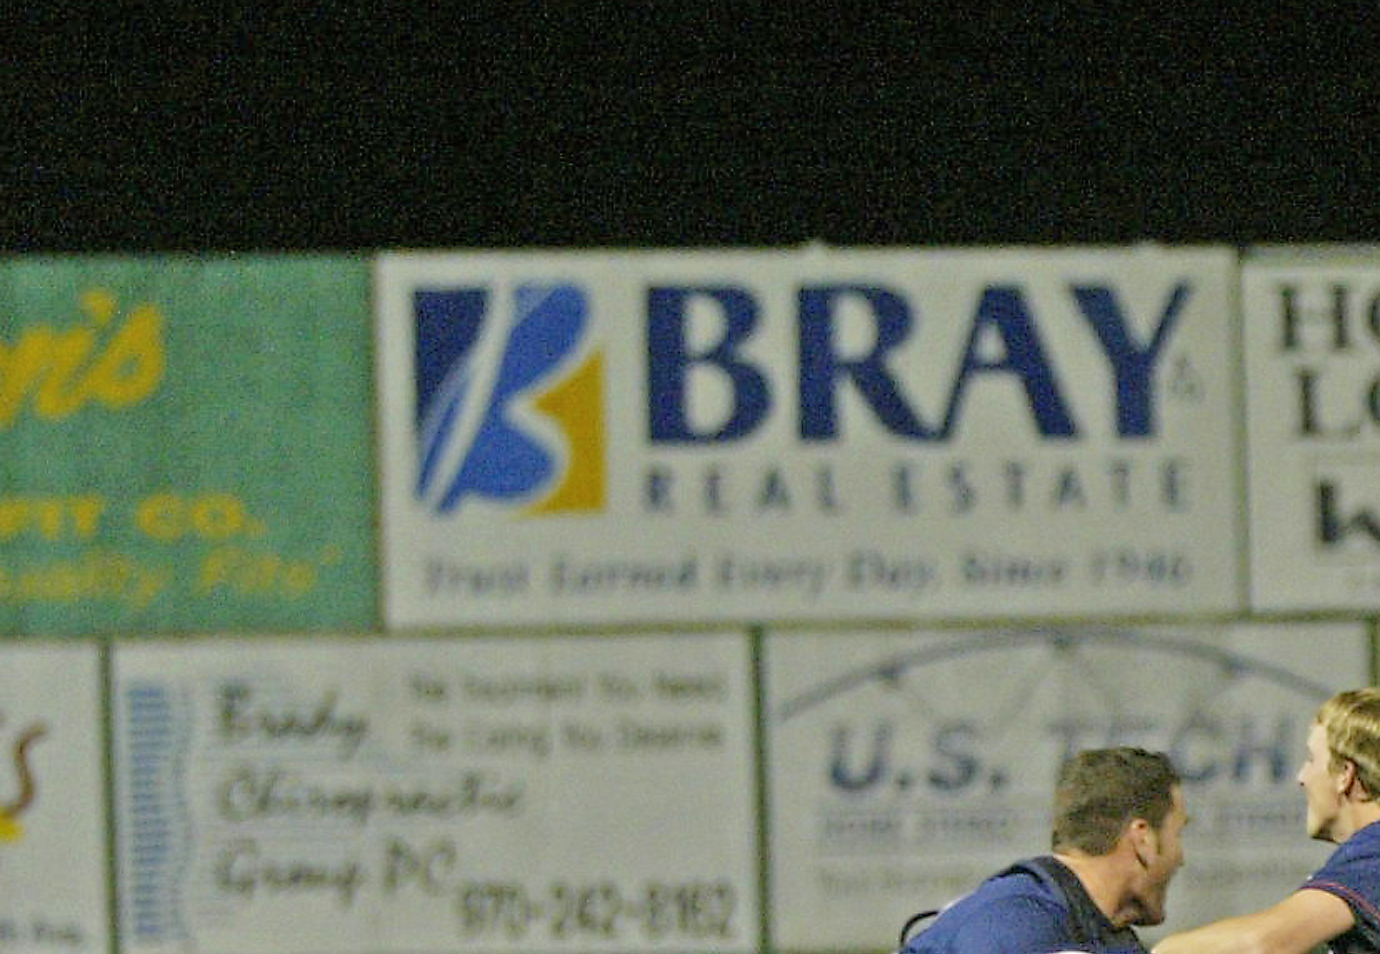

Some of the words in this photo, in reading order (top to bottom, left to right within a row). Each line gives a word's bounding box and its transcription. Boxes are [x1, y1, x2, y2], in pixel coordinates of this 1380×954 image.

[645, 282, 1190, 445] BRAY
[644, 465, 838, 516] REAL
[890, 455, 1188, 514] ESTATE
[828, 724, 1006, 794] U.S.
